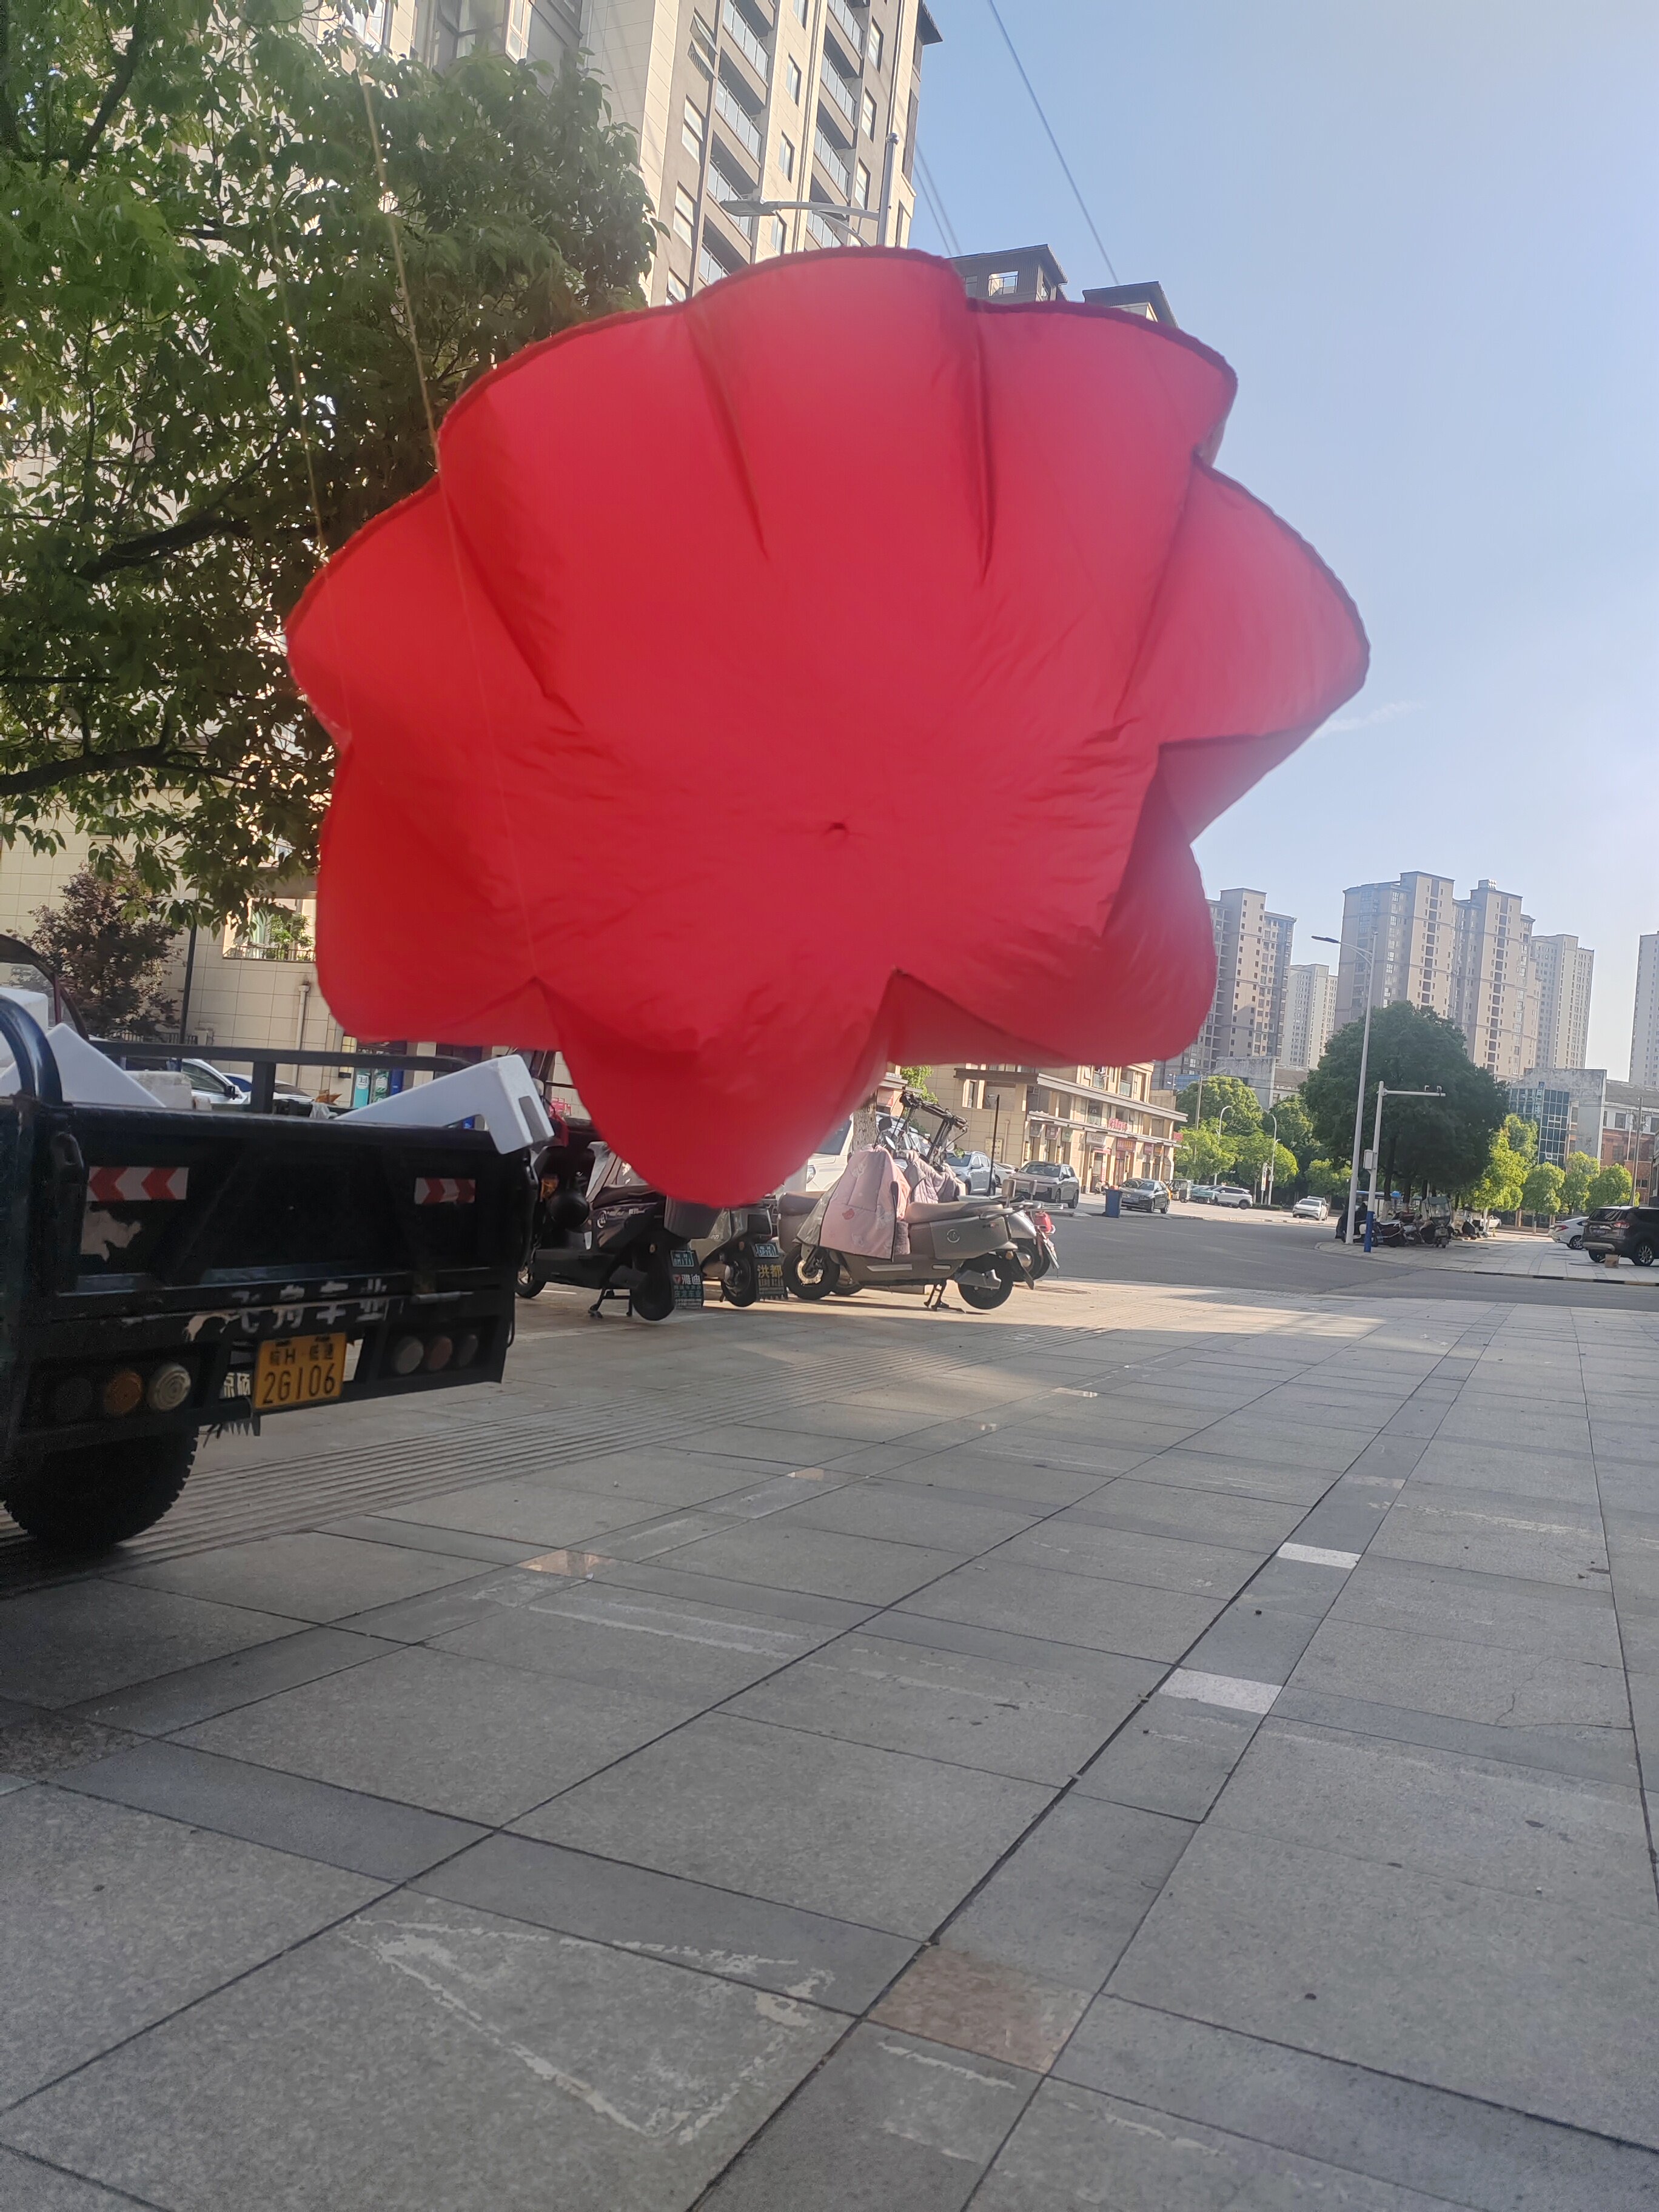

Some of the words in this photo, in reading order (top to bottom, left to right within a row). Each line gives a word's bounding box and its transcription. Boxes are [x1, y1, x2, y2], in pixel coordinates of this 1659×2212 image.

[757, 1264, 783, 1278] 洪都
[682, 1274, 701, 1285] 雅迪
[263, 1363, 335, 1404] 2G106
